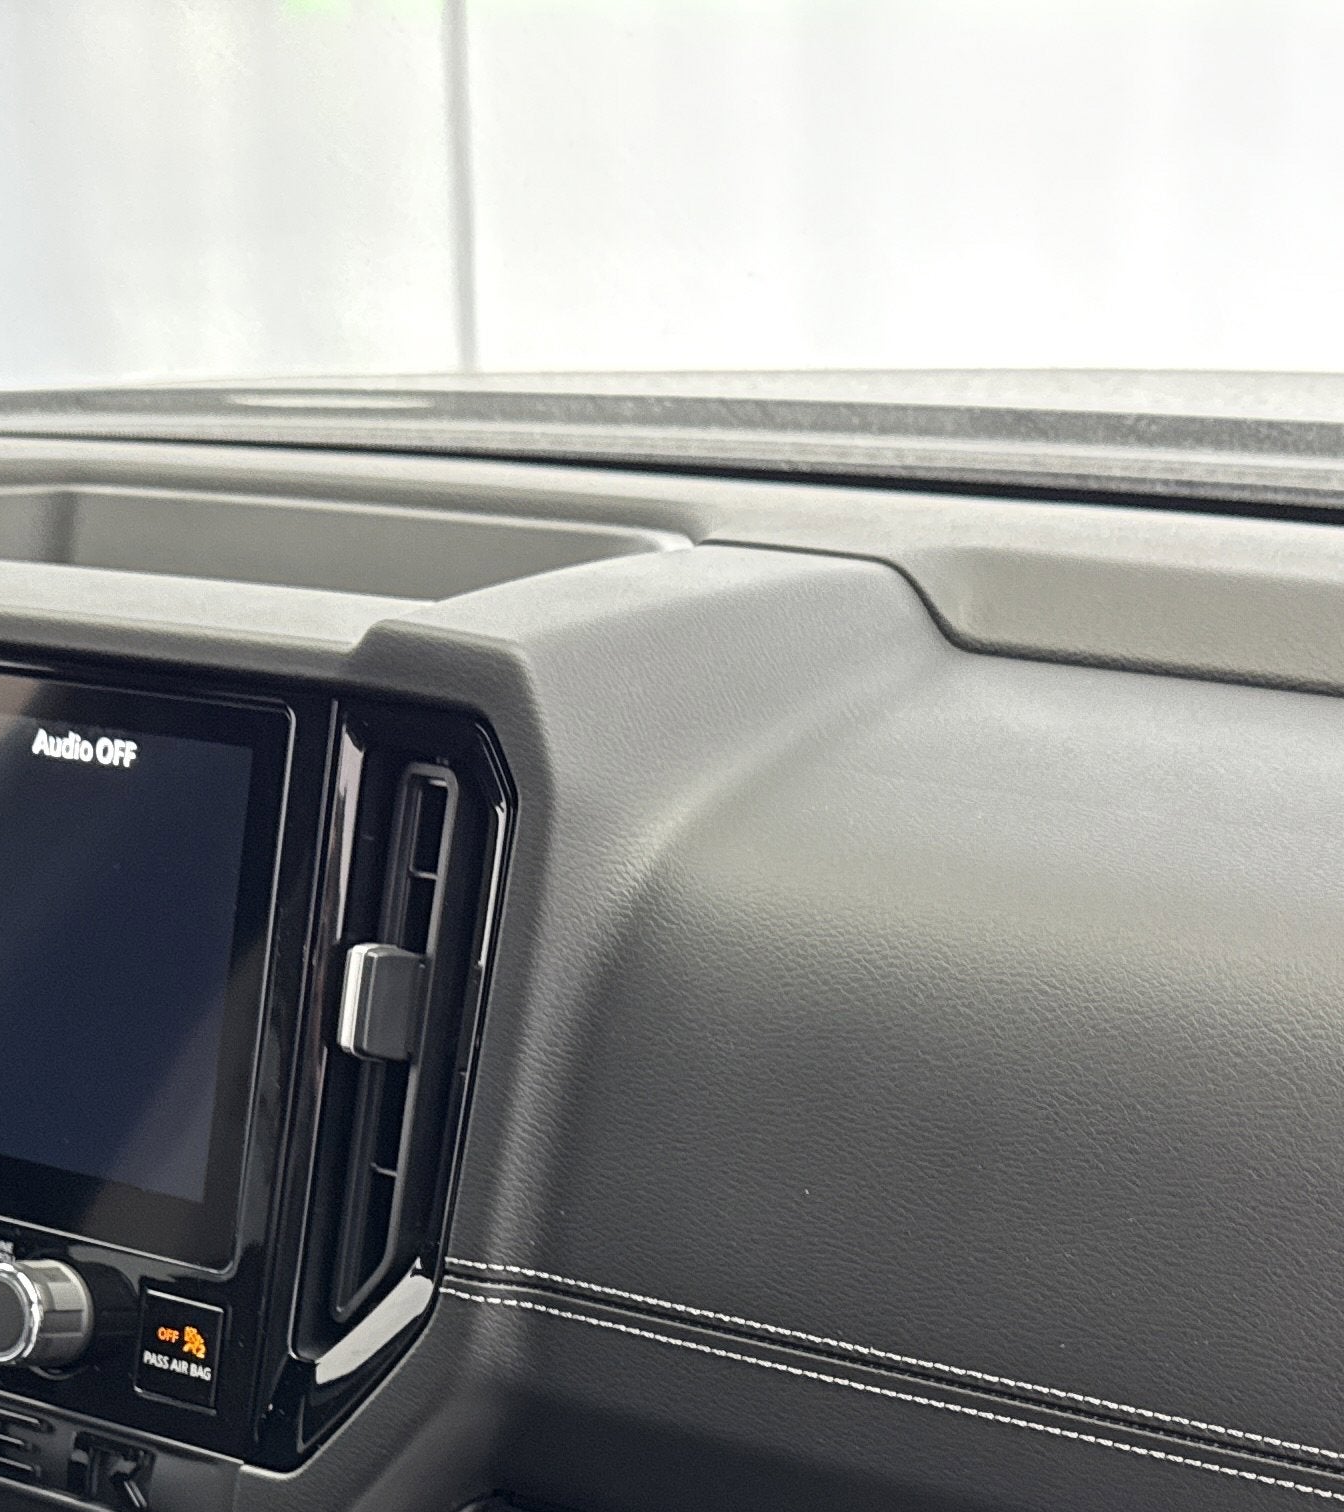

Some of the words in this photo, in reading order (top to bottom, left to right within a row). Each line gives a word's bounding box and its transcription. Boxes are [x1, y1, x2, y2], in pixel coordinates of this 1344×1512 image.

[31, 727, 94, 762] Audio
[95, 736, 138, 768] OFF
[157, 1326, 180, 1343] OFF
[143, 1350, 170, 1370] PASS
[170, 1358, 189, 1375] AIR
[189, 1363, 212, 1382] BAG
